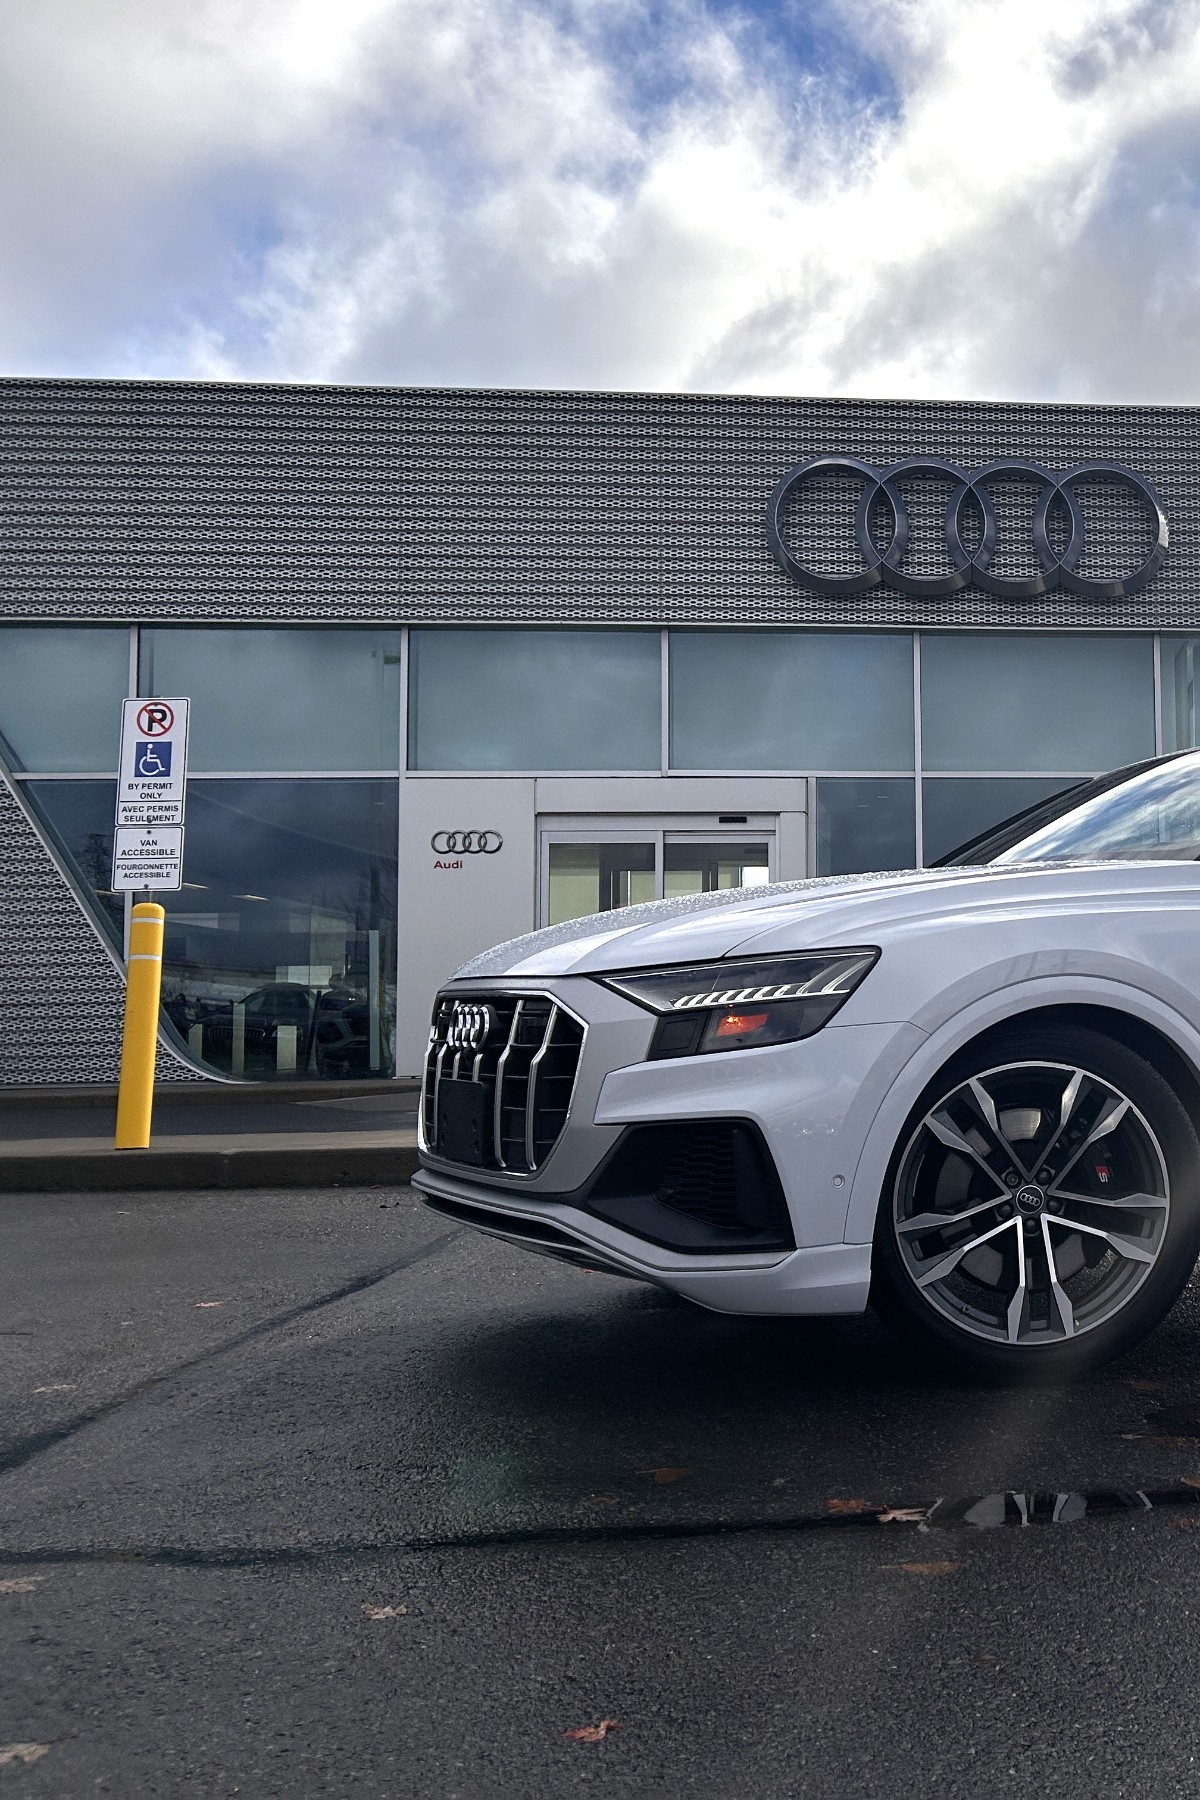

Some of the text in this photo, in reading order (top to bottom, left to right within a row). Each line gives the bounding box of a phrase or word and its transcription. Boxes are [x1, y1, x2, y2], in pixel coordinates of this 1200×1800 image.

[141, 782, 173, 790] PERMIT
[139, 792, 163, 800] ONLY
[121, 804, 179, 813] AVEC PERMIS
[123, 814, 176, 823] SEULEMENT
[140, 839, 158, 847] VAN
[120, 848, 176, 856] ACCESSIBLE
[116, 863, 179, 871] FOURGONNETTE
[433, 860, 463, 869] Audi
[122, 871, 171, 879] ACCESSIBLE
